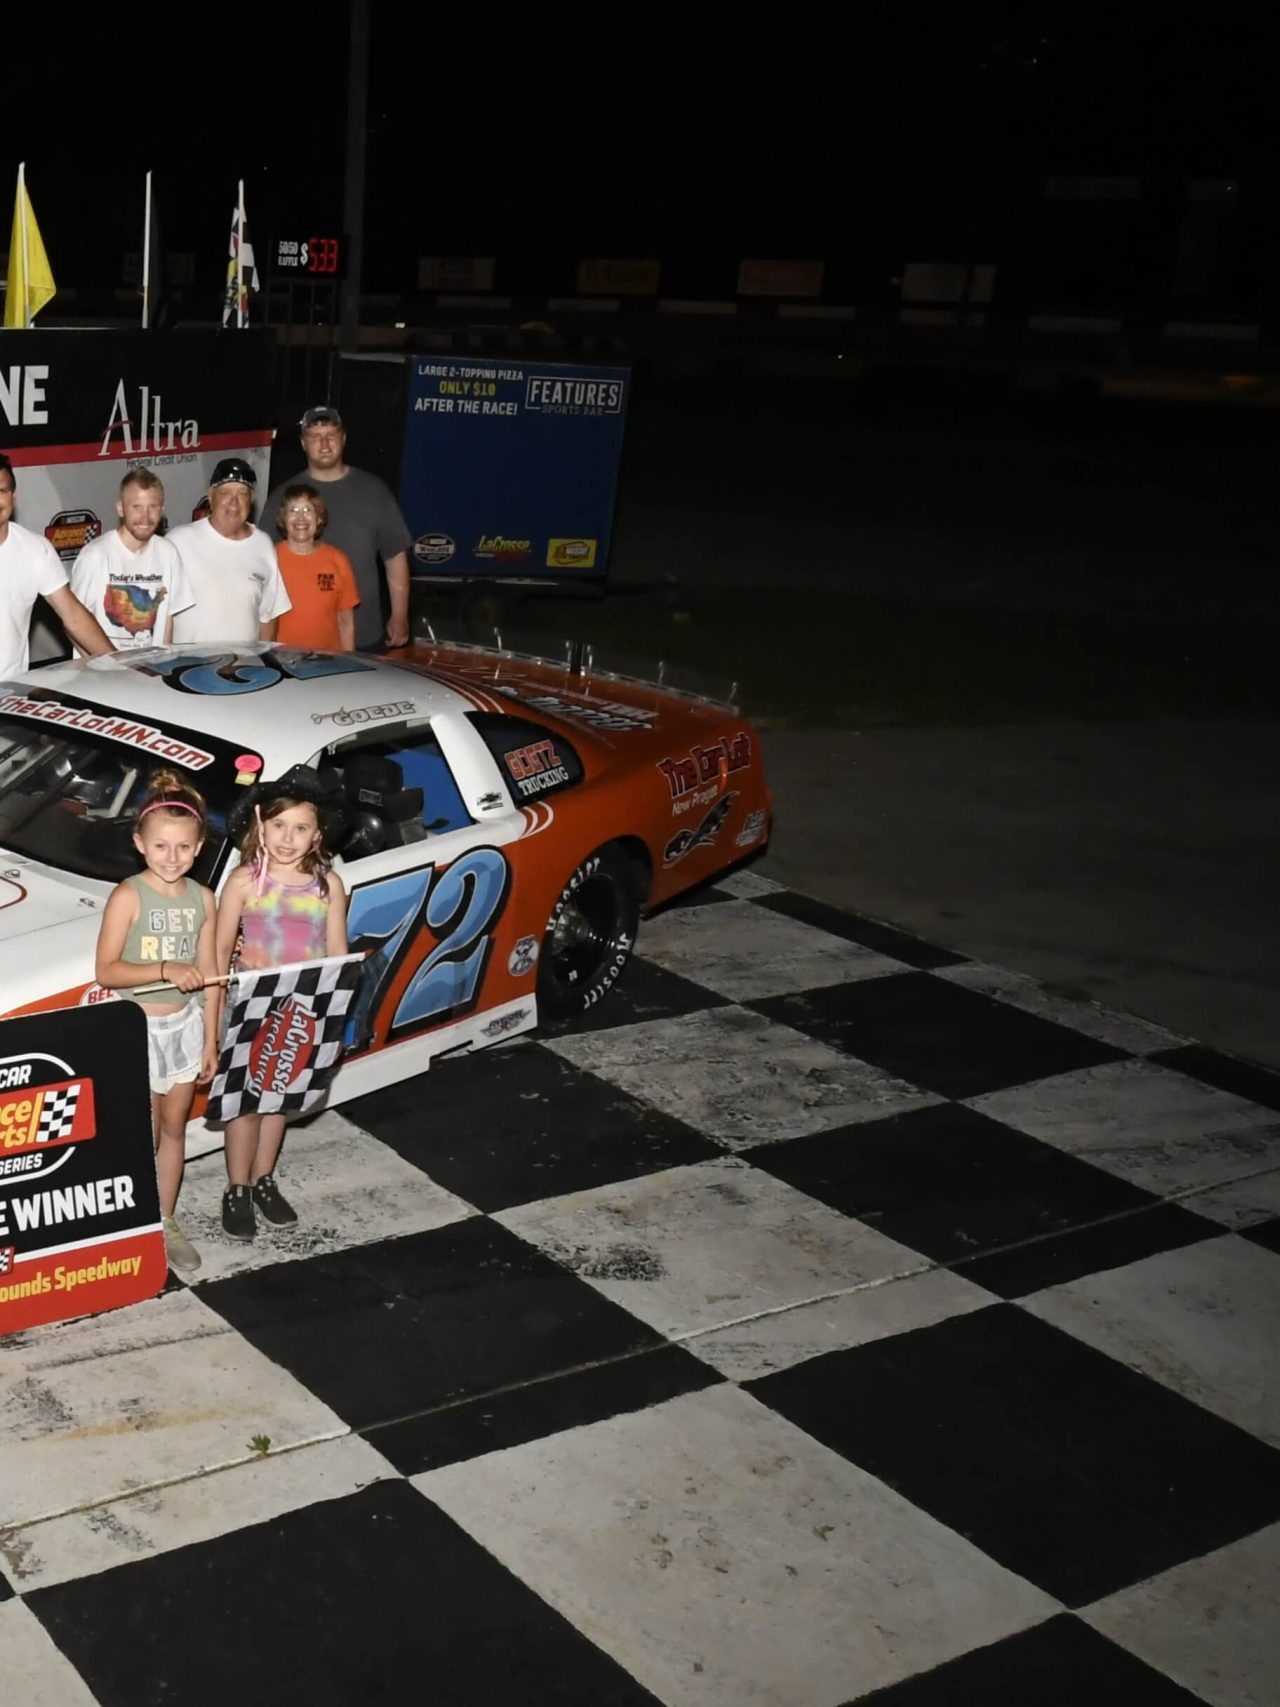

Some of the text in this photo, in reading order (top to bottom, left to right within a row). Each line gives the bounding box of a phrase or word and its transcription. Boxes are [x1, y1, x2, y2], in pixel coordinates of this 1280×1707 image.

[418, 364, 524, 381] LARGE 2-TOPPING PIZZA
[438, 380, 497, 397] ONLY $10
[530, 380, 619, 407] FEATURES
[97, 377, 201, 457] Altra
[414, 397, 518, 416] AFTER THE RACE!
[540, 405, 605, 416] SPORTS BAR
[503, 739, 562, 781] GOETZ
[517, 766, 570, 796] TRUCKING
[671, 800, 692, 818] New
[149, 908, 197, 934] GET
[140, 935, 198, 961] REA
[345, 845, 510, 1043] 72
[245, 991, 295, 1099] Speedway
[271, 1002, 318, 1096] LaCrosse
[10, 1174, 137, 1233] WINNER
[54, 1254, 142, 1293] Speedway
